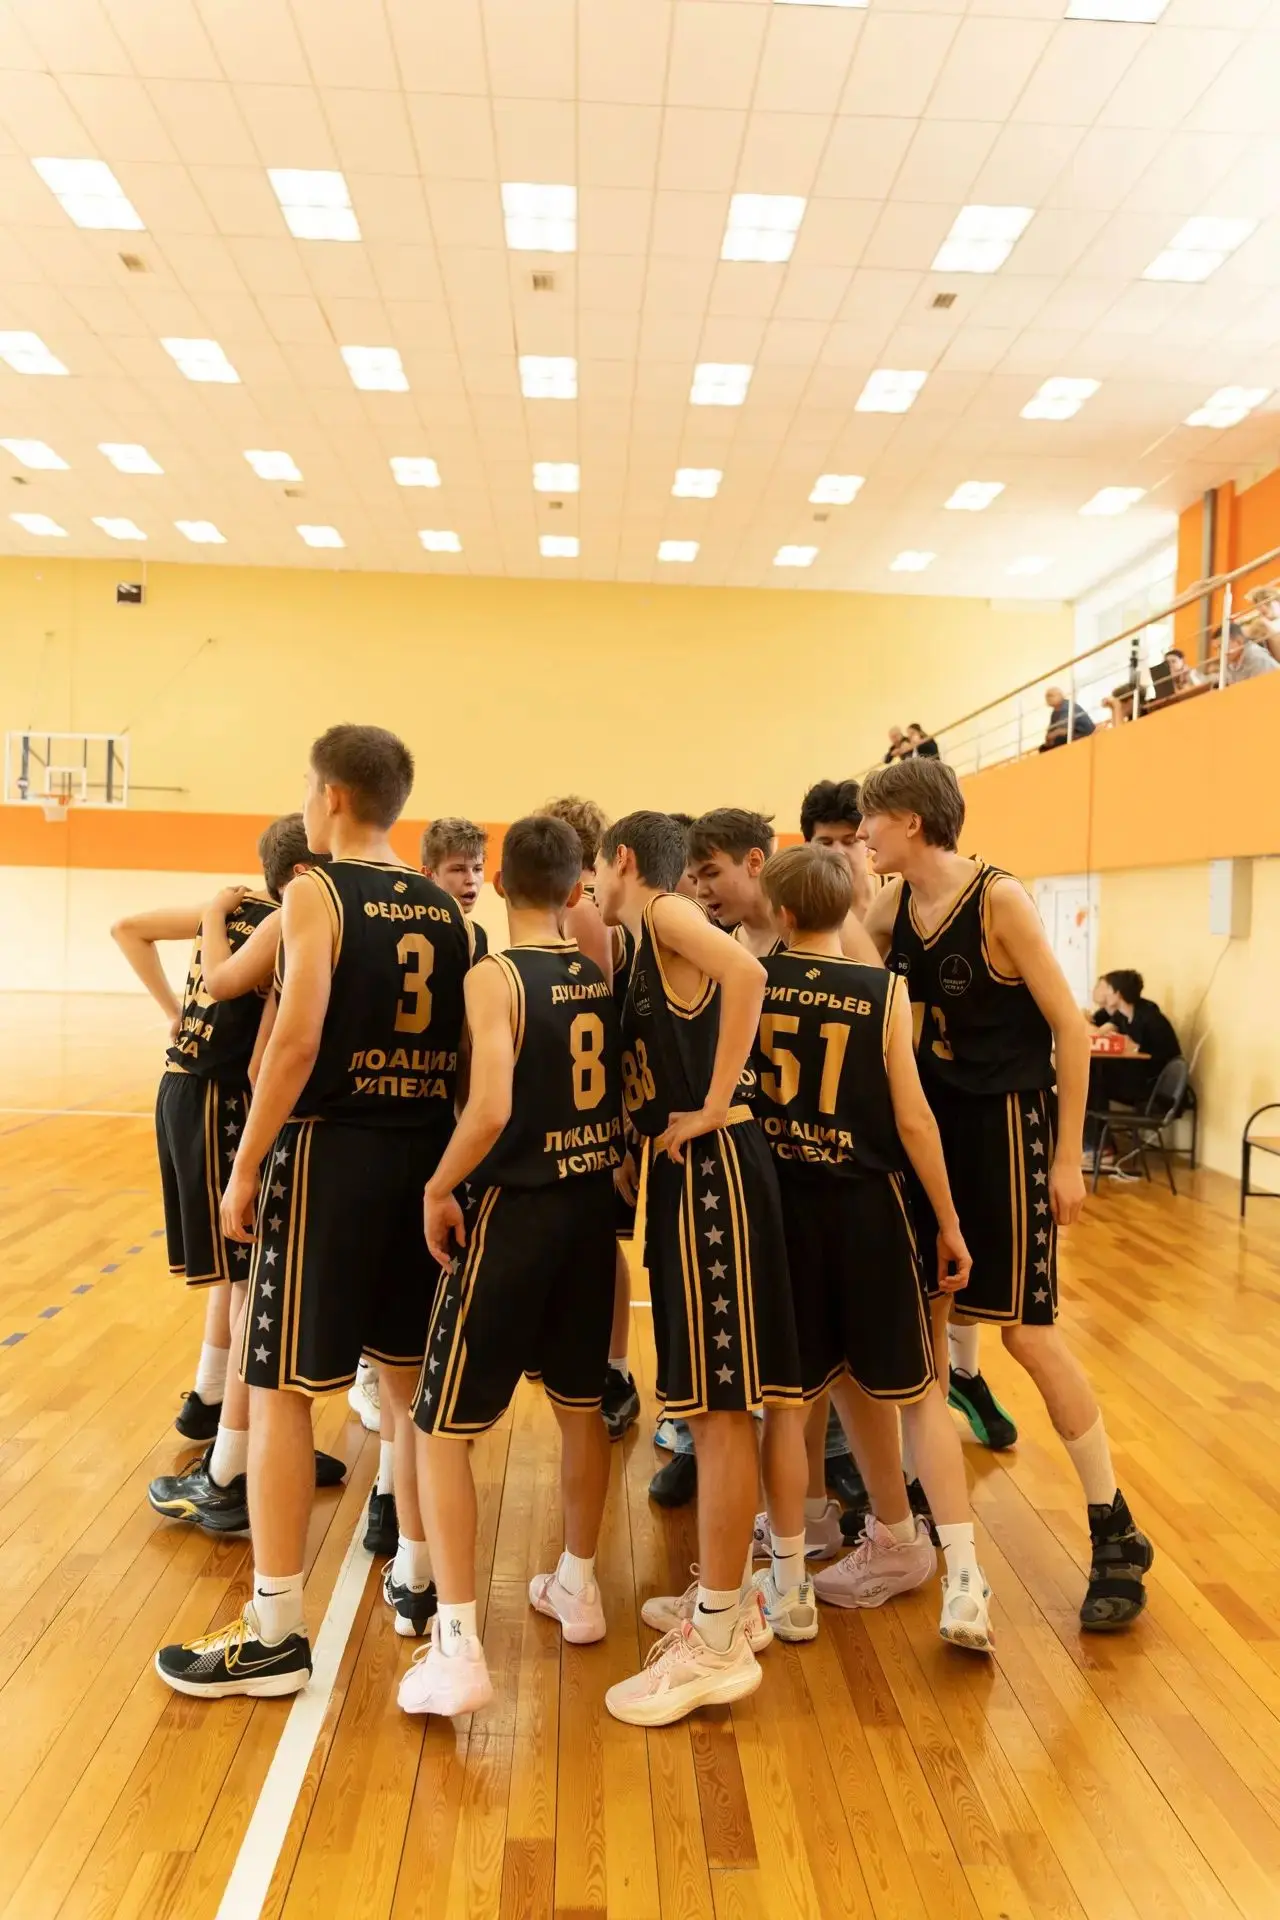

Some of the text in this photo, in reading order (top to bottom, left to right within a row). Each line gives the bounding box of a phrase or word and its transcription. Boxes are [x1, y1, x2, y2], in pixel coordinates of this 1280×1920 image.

[363, 901, 452, 924] ФЕДОРОВ
[394, 932, 435, 1034] 3
[763, 986, 872, 1017] РИГОРЬЕВ
[347, 1047, 458, 1075] ЛОАЦИЯ
[570, 1012, 606, 1112] 8
[621, 1037, 657, 1113] 88
[759, 1012, 851, 1116] 51
[543, 1116, 622, 1153] ЛОКАЦЯ
[759, 1116, 855, 1150] ОКАЦИЯ
[769, 1140, 856, 1166] СПЕХА
